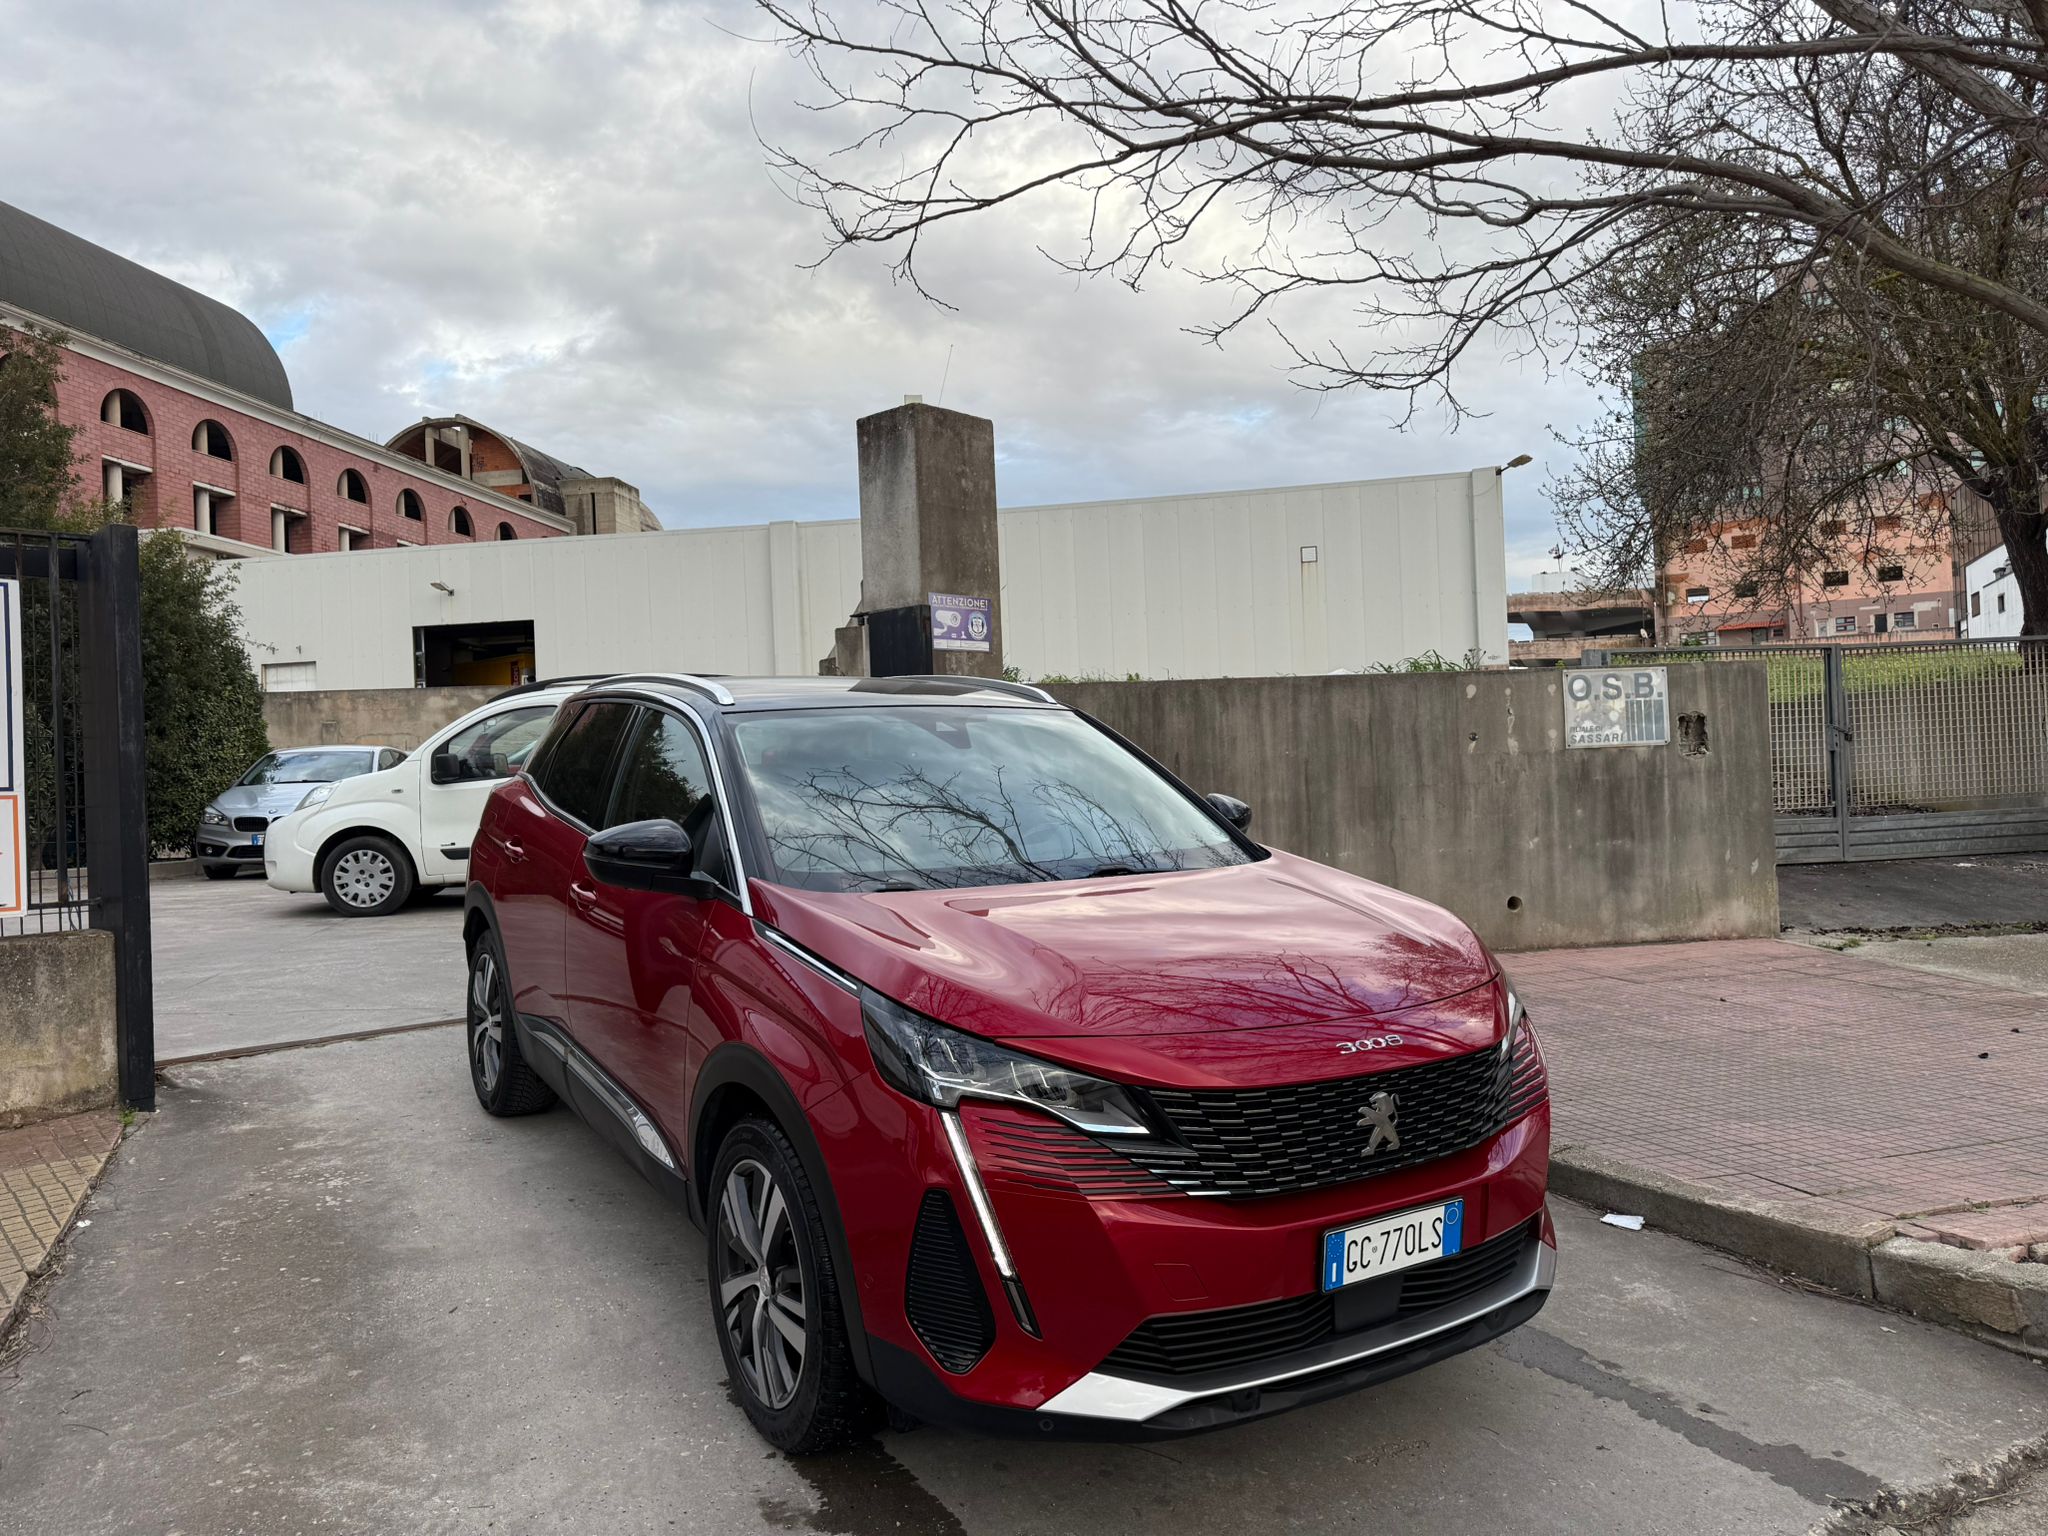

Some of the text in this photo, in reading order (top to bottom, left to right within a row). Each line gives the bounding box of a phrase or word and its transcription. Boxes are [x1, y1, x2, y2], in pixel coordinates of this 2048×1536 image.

[932, 595, 988, 609] ATTENZIONE!
[1567, 672, 1664, 702] O.S.B.
[1570, 733, 1624, 744] SASSARI
[1336, 1034, 1403, 1054] 3008
